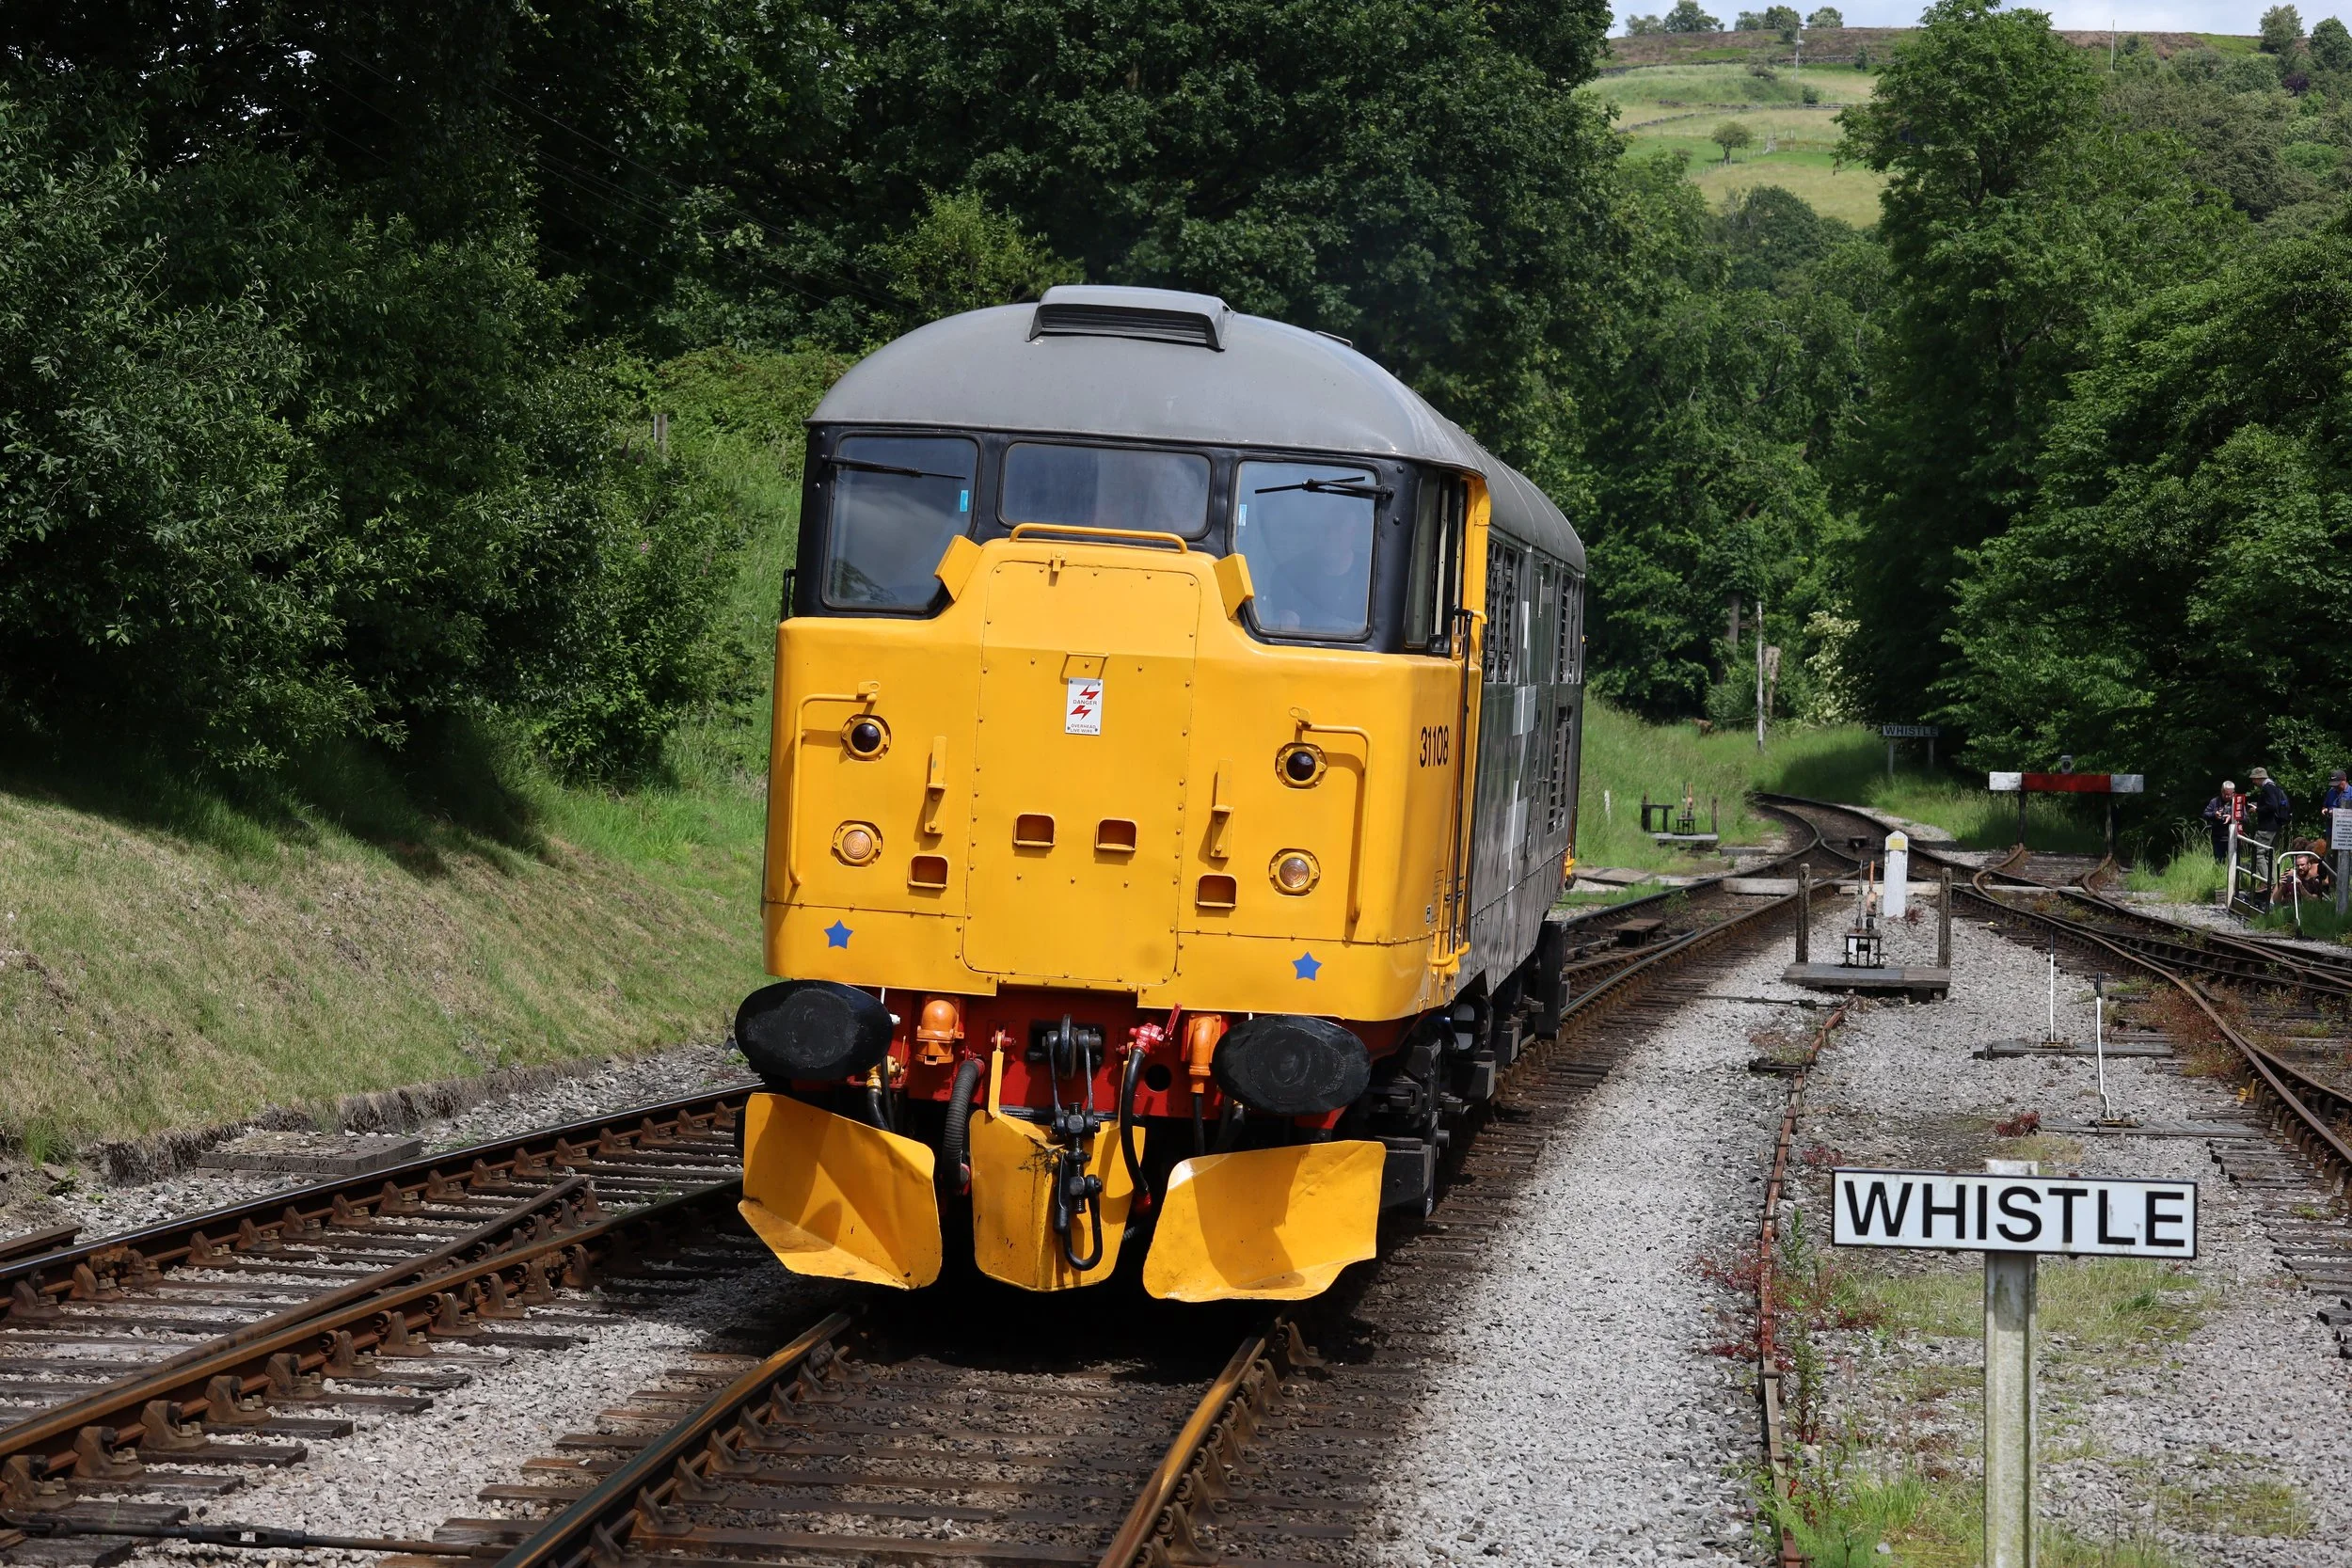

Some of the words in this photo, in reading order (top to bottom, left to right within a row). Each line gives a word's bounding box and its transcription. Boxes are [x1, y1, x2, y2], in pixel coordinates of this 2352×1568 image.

[1420, 725, 1449, 768] 31108
[1885, 726, 1936, 736] WHISTLE
[1843, 1180, 2185, 1247] WHISTLE
